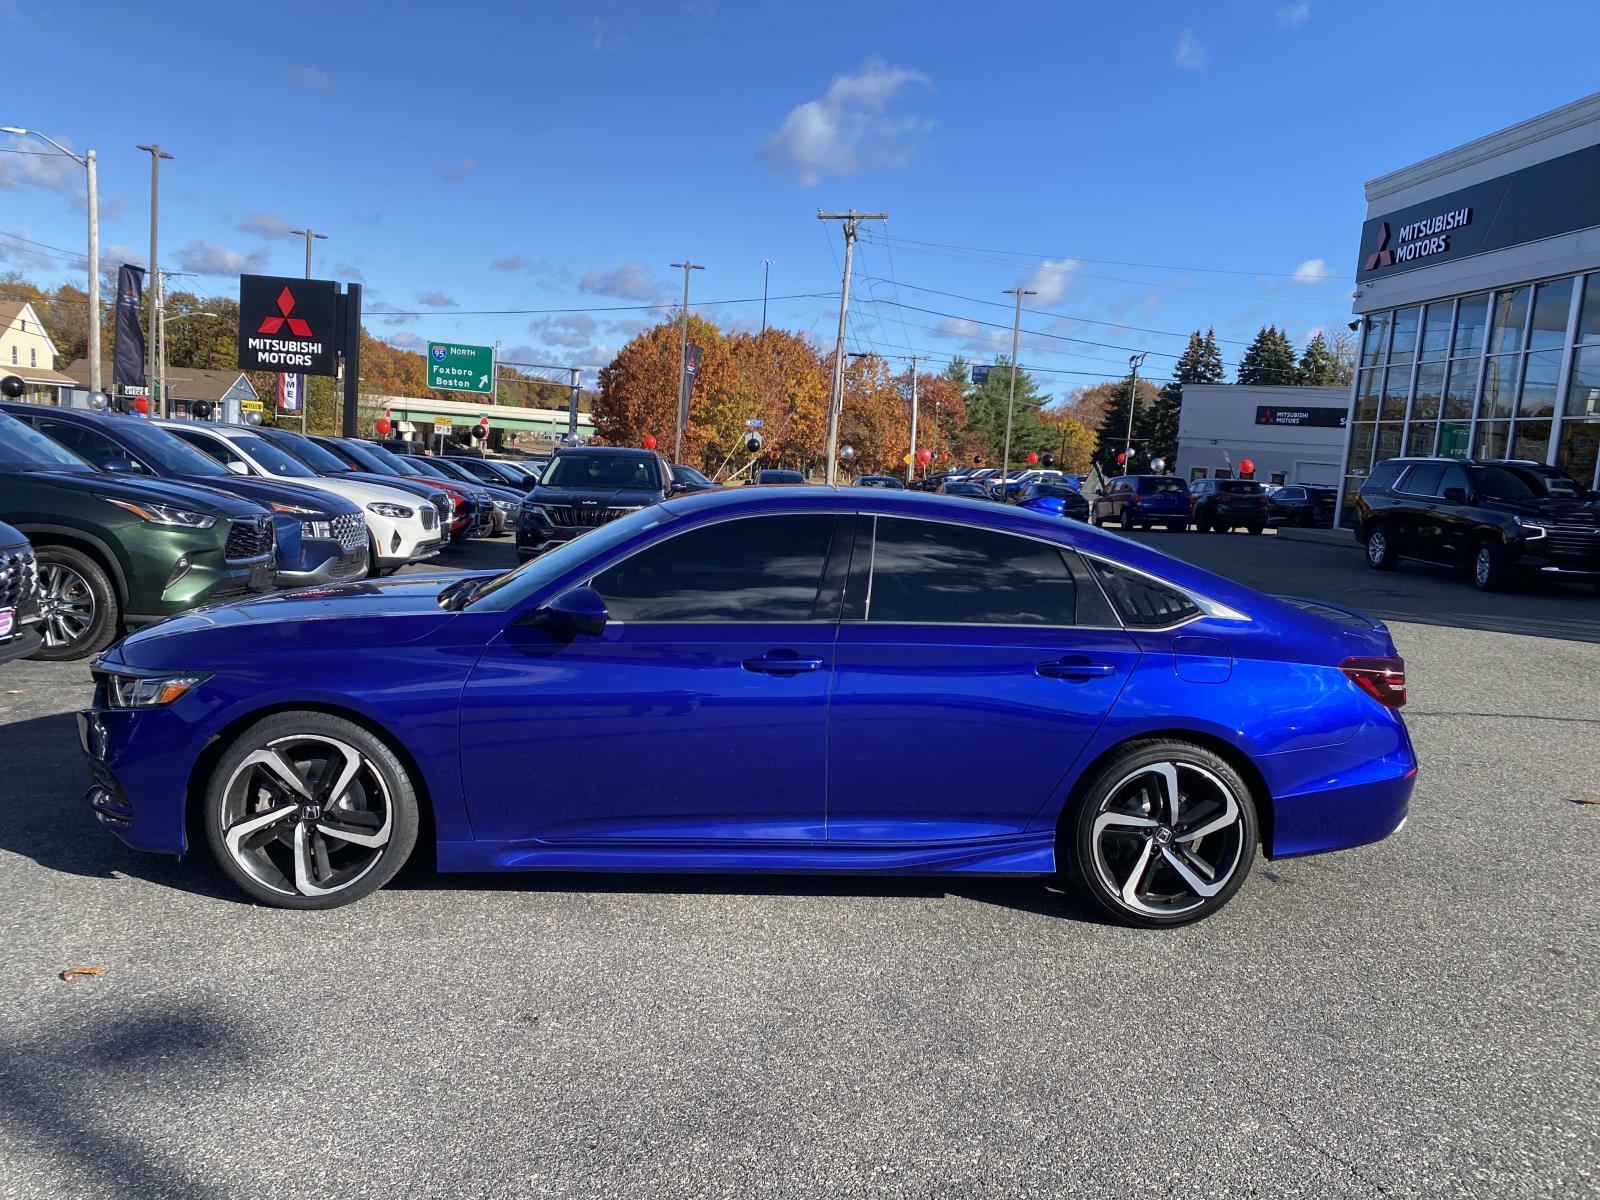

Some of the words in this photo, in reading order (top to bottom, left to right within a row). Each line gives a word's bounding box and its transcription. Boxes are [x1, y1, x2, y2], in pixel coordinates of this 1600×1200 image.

[1399, 208, 1469, 243] MITSUBISHI
[1396, 235, 1446, 263] MOTORS
[248, 338, 322, 354] MITSUBISHI
[434, 350, 445, 358] 95
[450, 347, 476, 356] NORTH
[257, 351, 312, 366] MOTORS
[433, 365, 473, 376] Foxboro
[436, 377, 470, 387] Boston
[1276, 411, 1309, 419] MITSUBISHI
